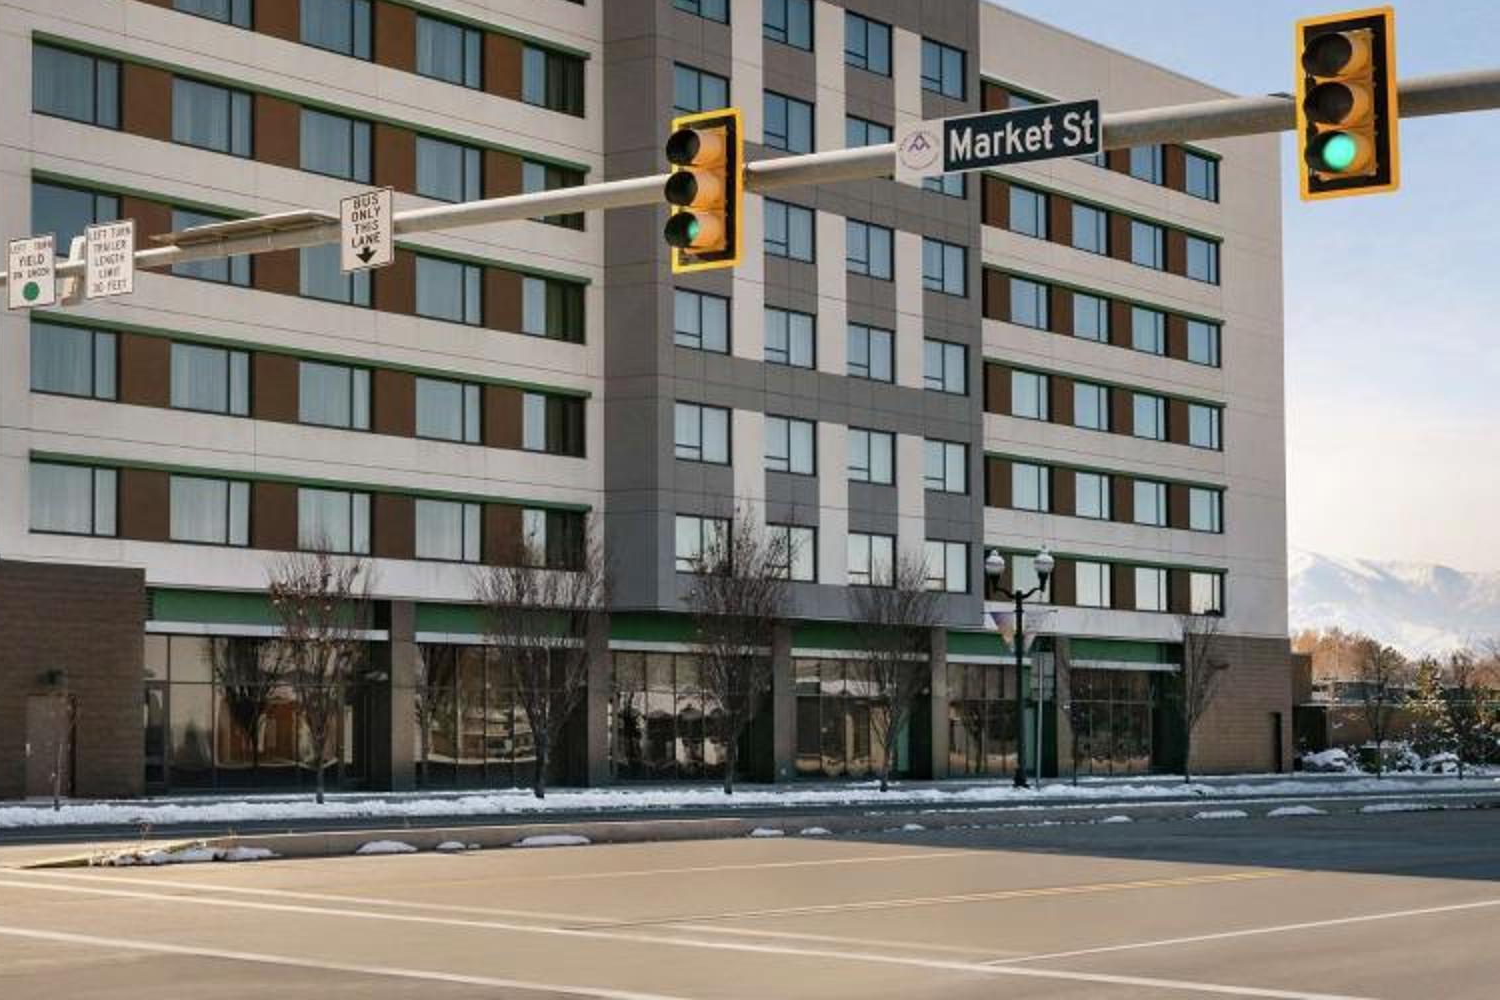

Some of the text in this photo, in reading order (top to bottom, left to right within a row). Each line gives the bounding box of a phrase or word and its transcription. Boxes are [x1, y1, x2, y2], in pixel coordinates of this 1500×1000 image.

[950, 110, 1095, 162] Market St
[353, 193, 379, 210] BUS
[351, 205, 381, 222] ONLY
[353, 219, 379, 235] THIS
[351, 231, 381, 248] LANE
[19, 254, 45, 267] YIELD
